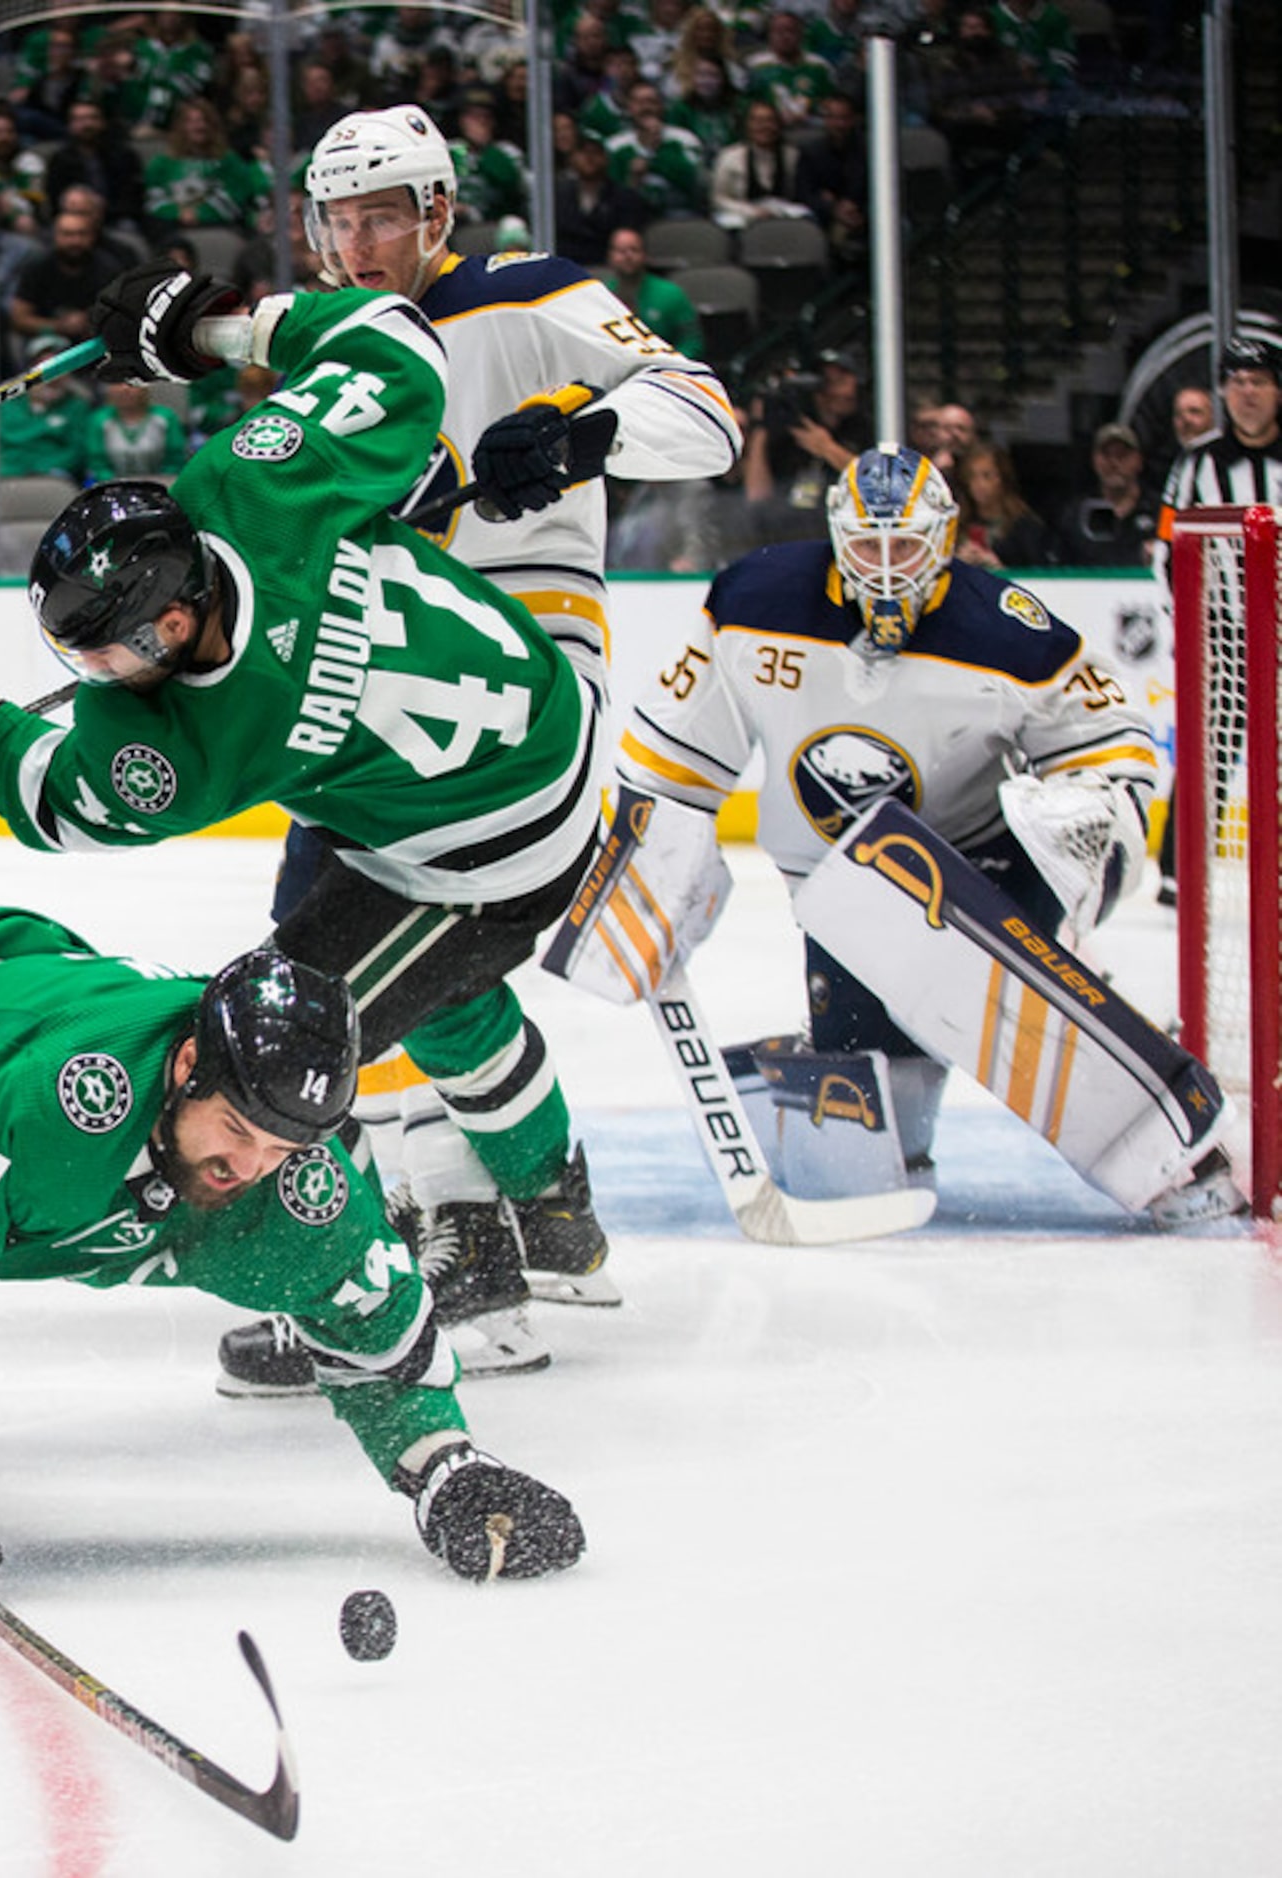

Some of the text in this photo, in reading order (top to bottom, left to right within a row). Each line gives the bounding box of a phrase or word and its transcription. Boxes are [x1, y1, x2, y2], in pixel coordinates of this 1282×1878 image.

[321, 165, 358, 179] CCM
[284, 537, 371, 757] RADULOV
[354, 543, 533, 780] 47
[872, 614, 903, 646] 35
[659, 644, 712, 701] 35
[754, 645, 807, 690] 35
[1061, 662, 1129, 712] 35
[569, 833, 622, 928] BAUER
[1000, 916, 1107, 1008] BAUER
[299, 1067, 330, 1107] 14
[659, 1001, 757, 1180] BAUER
[331, 1238, 413, 1318] 14
